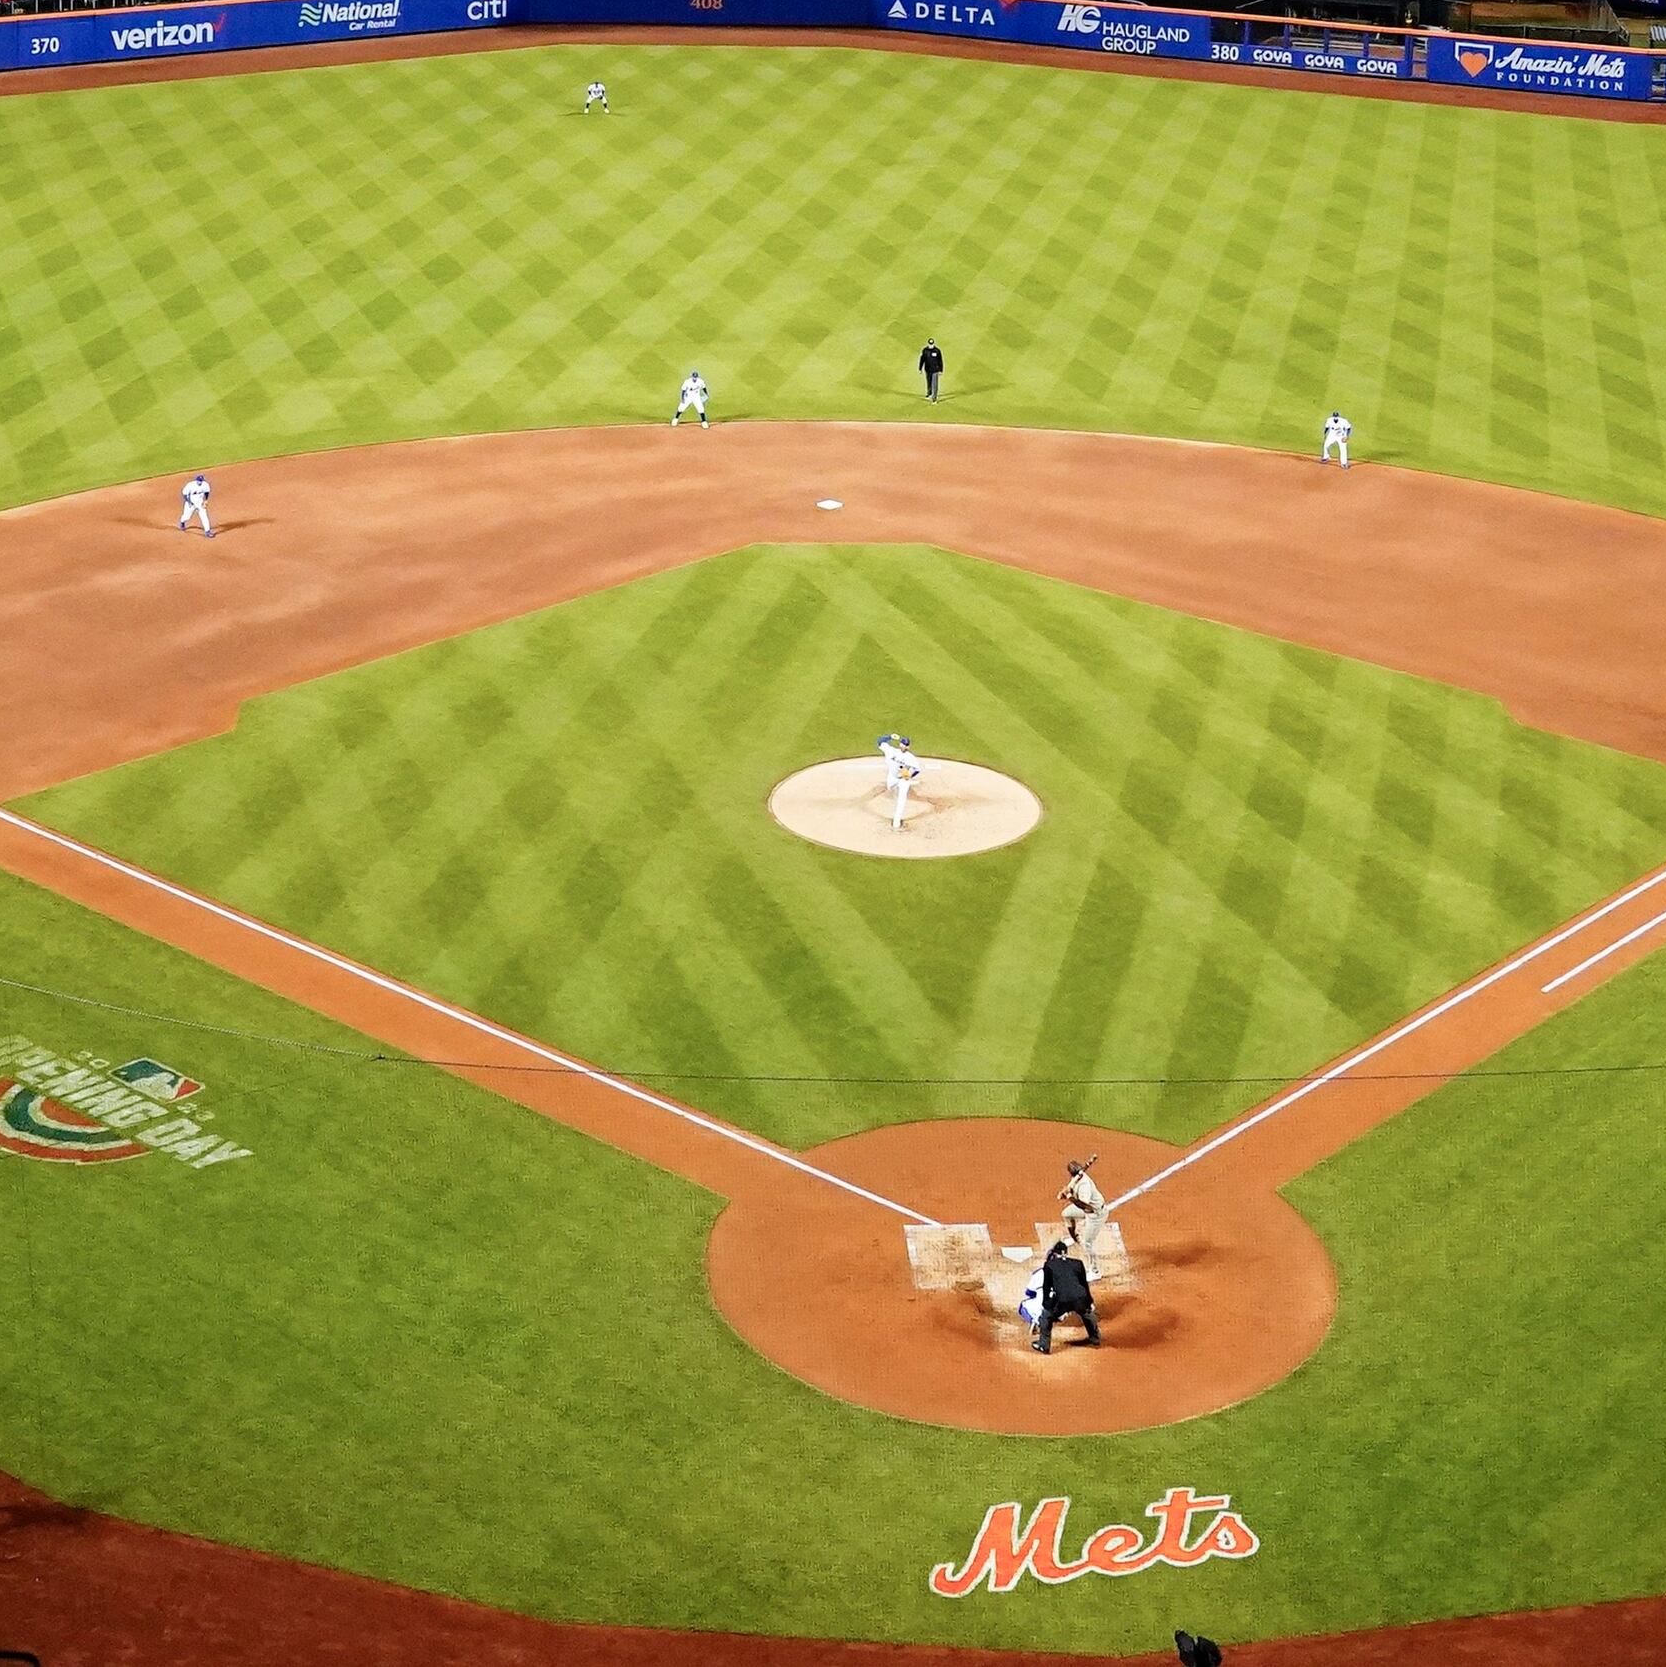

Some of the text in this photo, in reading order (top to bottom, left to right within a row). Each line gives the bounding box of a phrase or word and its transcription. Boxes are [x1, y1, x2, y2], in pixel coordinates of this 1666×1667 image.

[916, 2, 996, 26] DELTA
[349, 19, 396, 31] Car Rental
[1102, 24, 1190, 42] HAUGLAND
[112, 19, 214, 50] verizon
[31, 37, 59, 54] 370
[1102, 39, 1156, 53] GROUP
[1211, 45, 1238, 61] 380
[1253, 49, 1292, 64] GOYA
[1305, 54, 1344, 69] GOYA
[1495, 48, 1625, 78] Amazin' Mets
[1357, 59, 1397, 74] GOYA
[1497, 72, 1623, 91] FOUNDATION
[134, 1118, 254, 1168] DAY
[930, 1487, 1259, 1599] Mets
